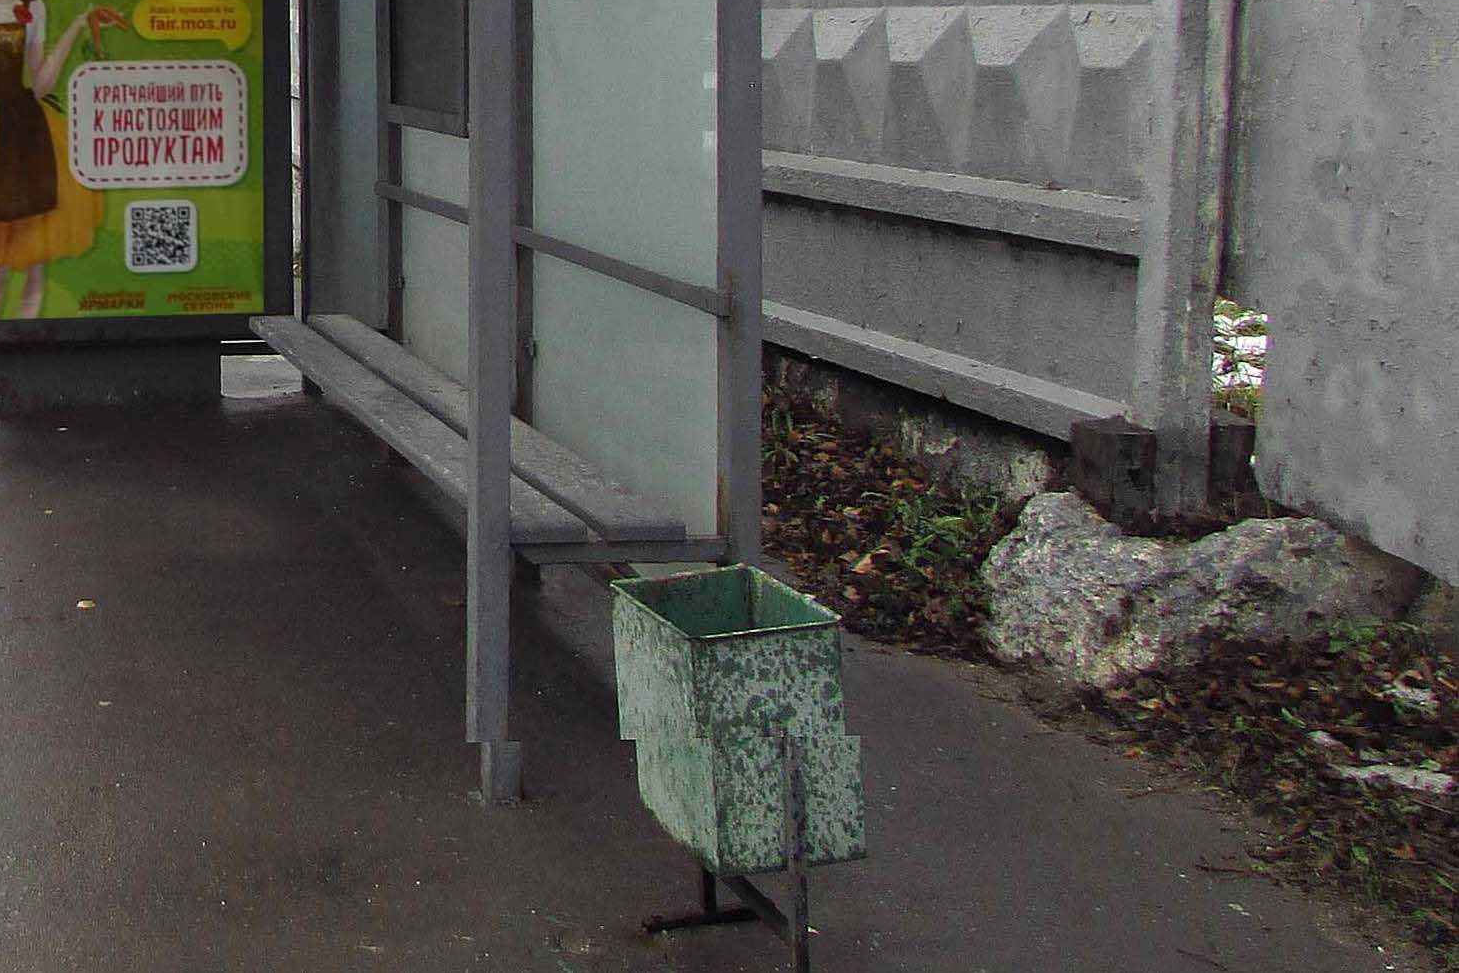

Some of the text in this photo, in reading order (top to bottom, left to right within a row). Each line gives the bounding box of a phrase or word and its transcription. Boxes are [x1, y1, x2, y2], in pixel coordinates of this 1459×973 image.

[149, 16, 237, 31] fair.mos.ru
[93, 82, 223, 103] КРАТЧАЙШИЙ ПУТЬ
[94, 107, 223, 132] К НАСТОЯЩИМ
[93, 135, 224, 167] ПРОДУКТАМ
